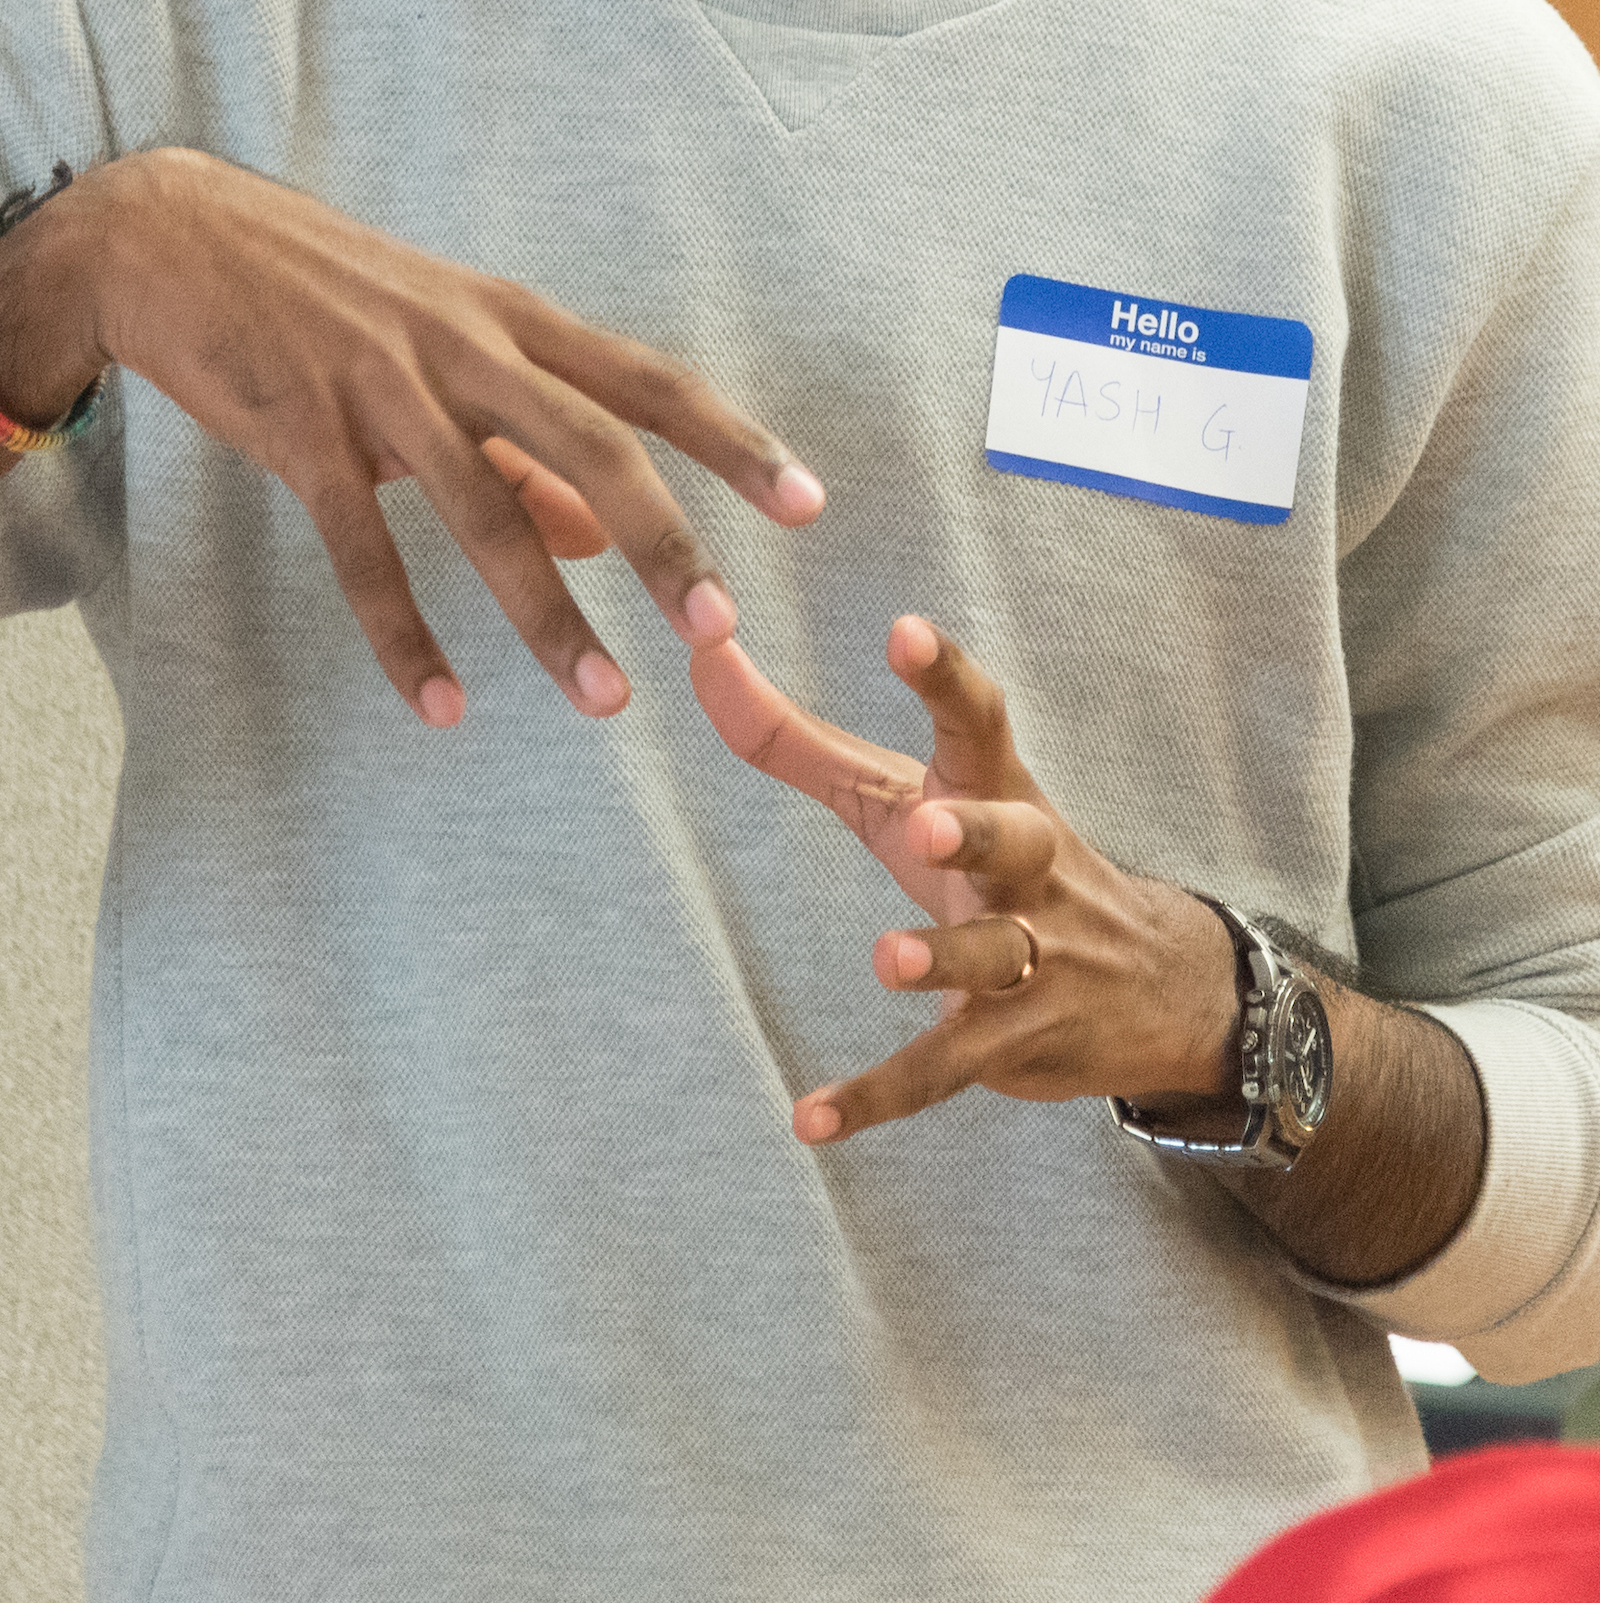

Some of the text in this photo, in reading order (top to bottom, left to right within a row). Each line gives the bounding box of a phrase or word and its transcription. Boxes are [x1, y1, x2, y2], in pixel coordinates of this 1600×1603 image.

[1111, 300, 1199, 344] Hello
[1109, 332, 1207, 363] my name is
[1031, 358, 1161, 436] YASH
